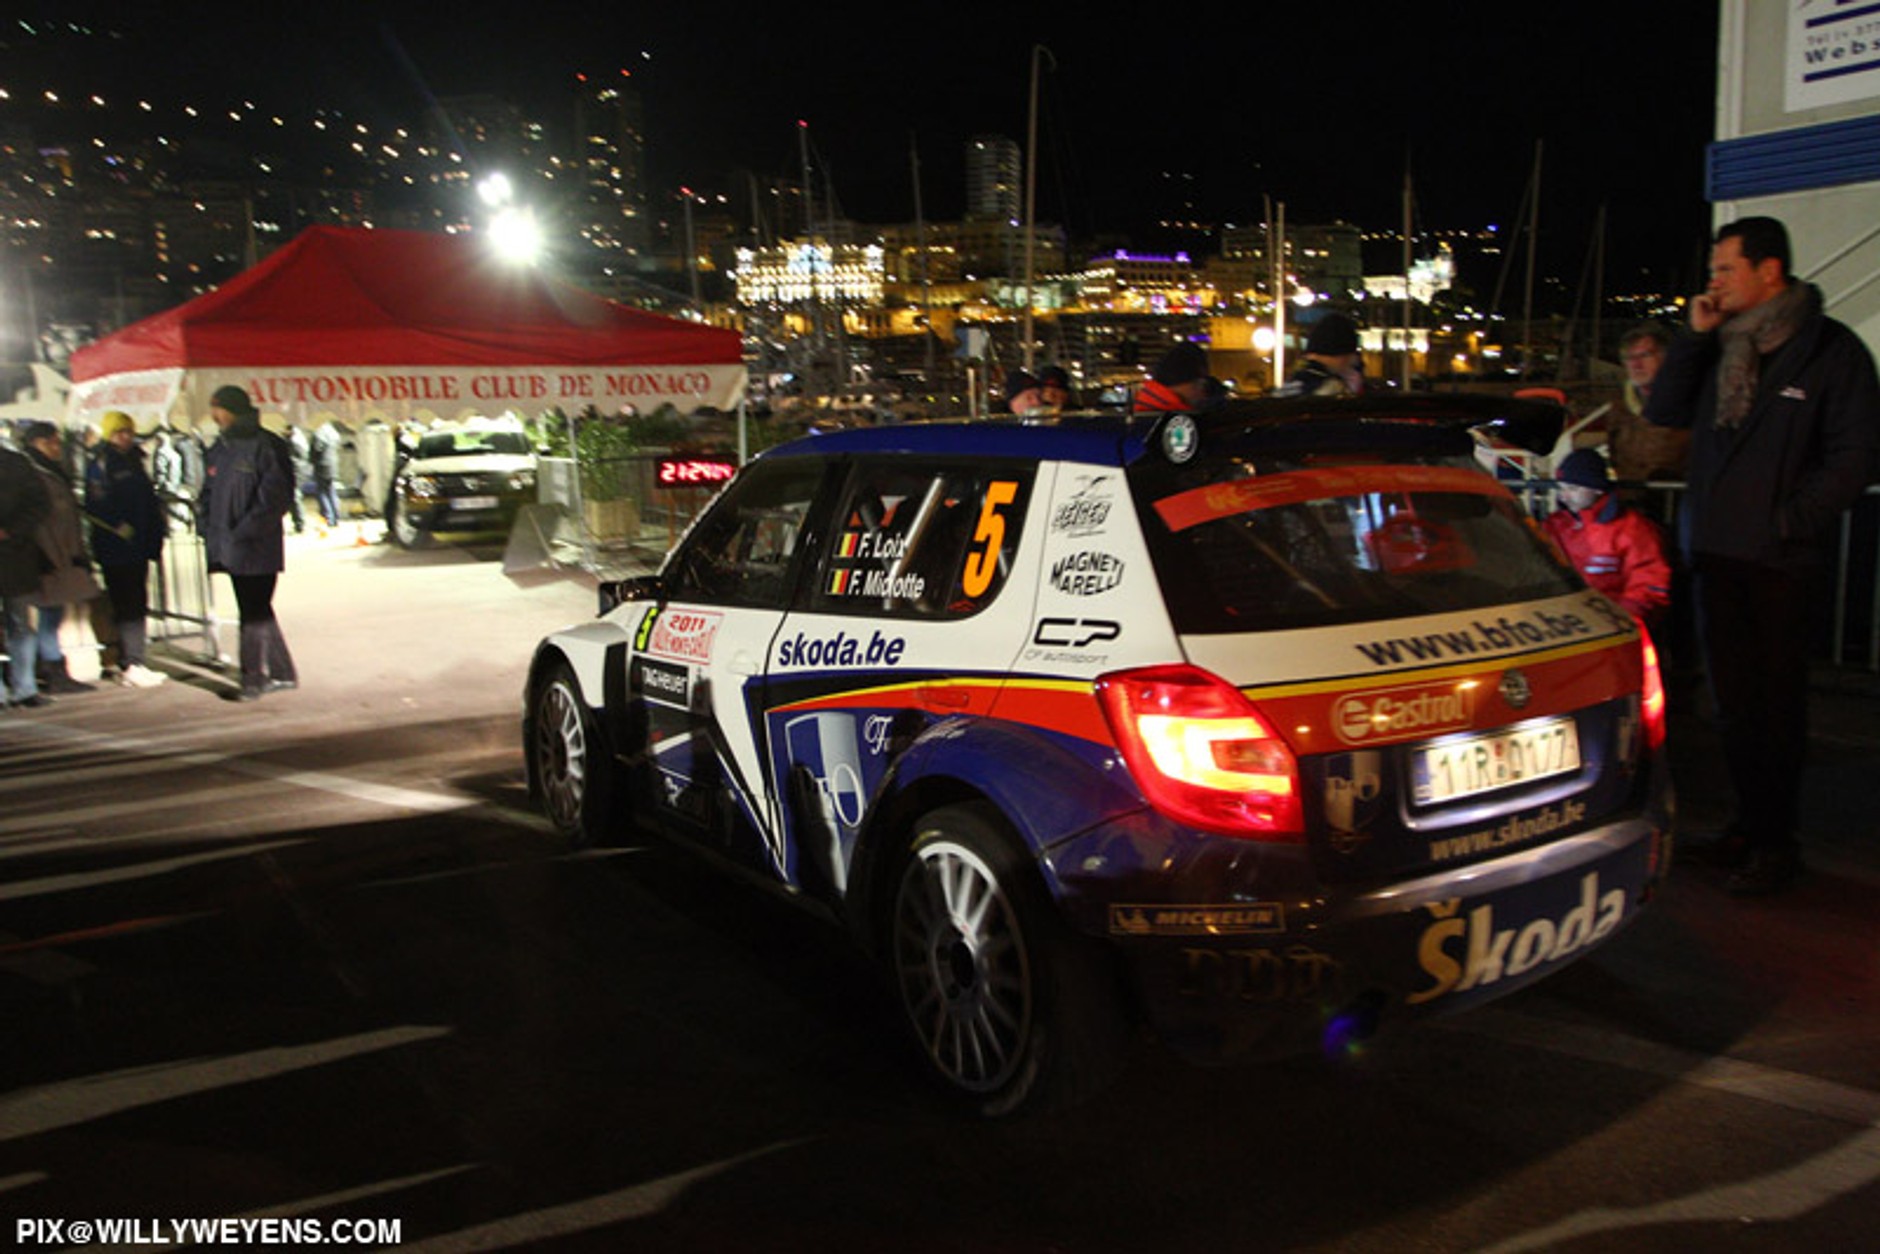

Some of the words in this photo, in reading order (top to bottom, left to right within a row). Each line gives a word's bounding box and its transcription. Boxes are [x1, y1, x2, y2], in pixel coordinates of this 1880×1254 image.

[250, 375, 460, 403] AUTOMOBILE
[471, 375, 547, 399] CLUB
[560, 375, 593, 397] DE
[606, 372, 711, 397] MONACO
[858, 532, 871, 558] F.
[962, 481, 1018, 598] 5
[848, 569, 863, 596] F.
[669, 615, 706, 632] 2011
[1034, 617, 1121, 647] CP
[1355, 610, 1591, 666] www.bfo.be
[779, 630, 905, 666] skoda.be
[1370, 688, 1467, 734] Castrol
[1431, 800, 1587, 861] www.skoda.be
[1154, 909, 1275, 926] MICHELIN
[1406, 872, 1626, 1004] Škoda
